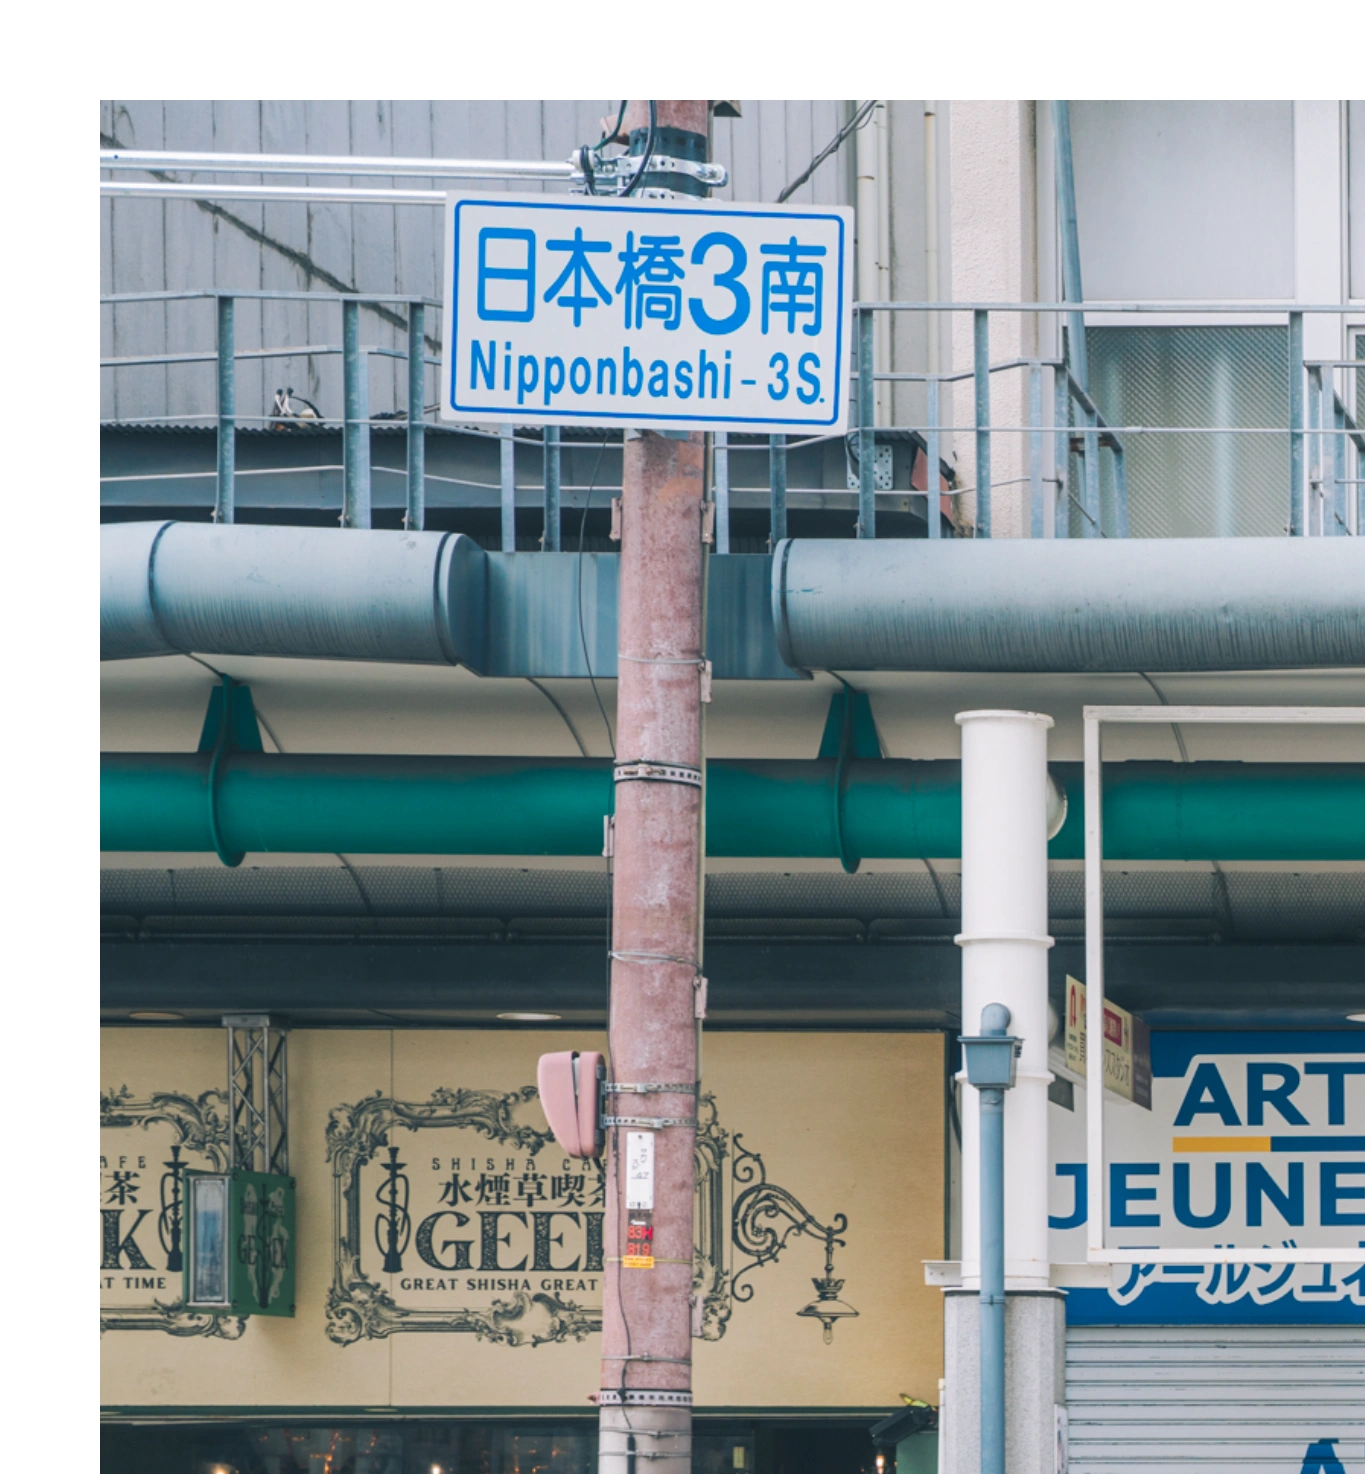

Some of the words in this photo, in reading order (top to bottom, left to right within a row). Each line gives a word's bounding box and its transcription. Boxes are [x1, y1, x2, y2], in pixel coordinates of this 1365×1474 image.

[476, 226, 828, 337] 日本橋3南
[431, 1157, 537, 1171] SHISHA
[100, 1171, 142, 1206] 茶
[123, 1277, 167, 1290] TIME
[400, 1278, 459, 1291] GREAT
[466, 1278, 532, 1291] SHISHA
[540, 1278, 598, 1291] GREAT
